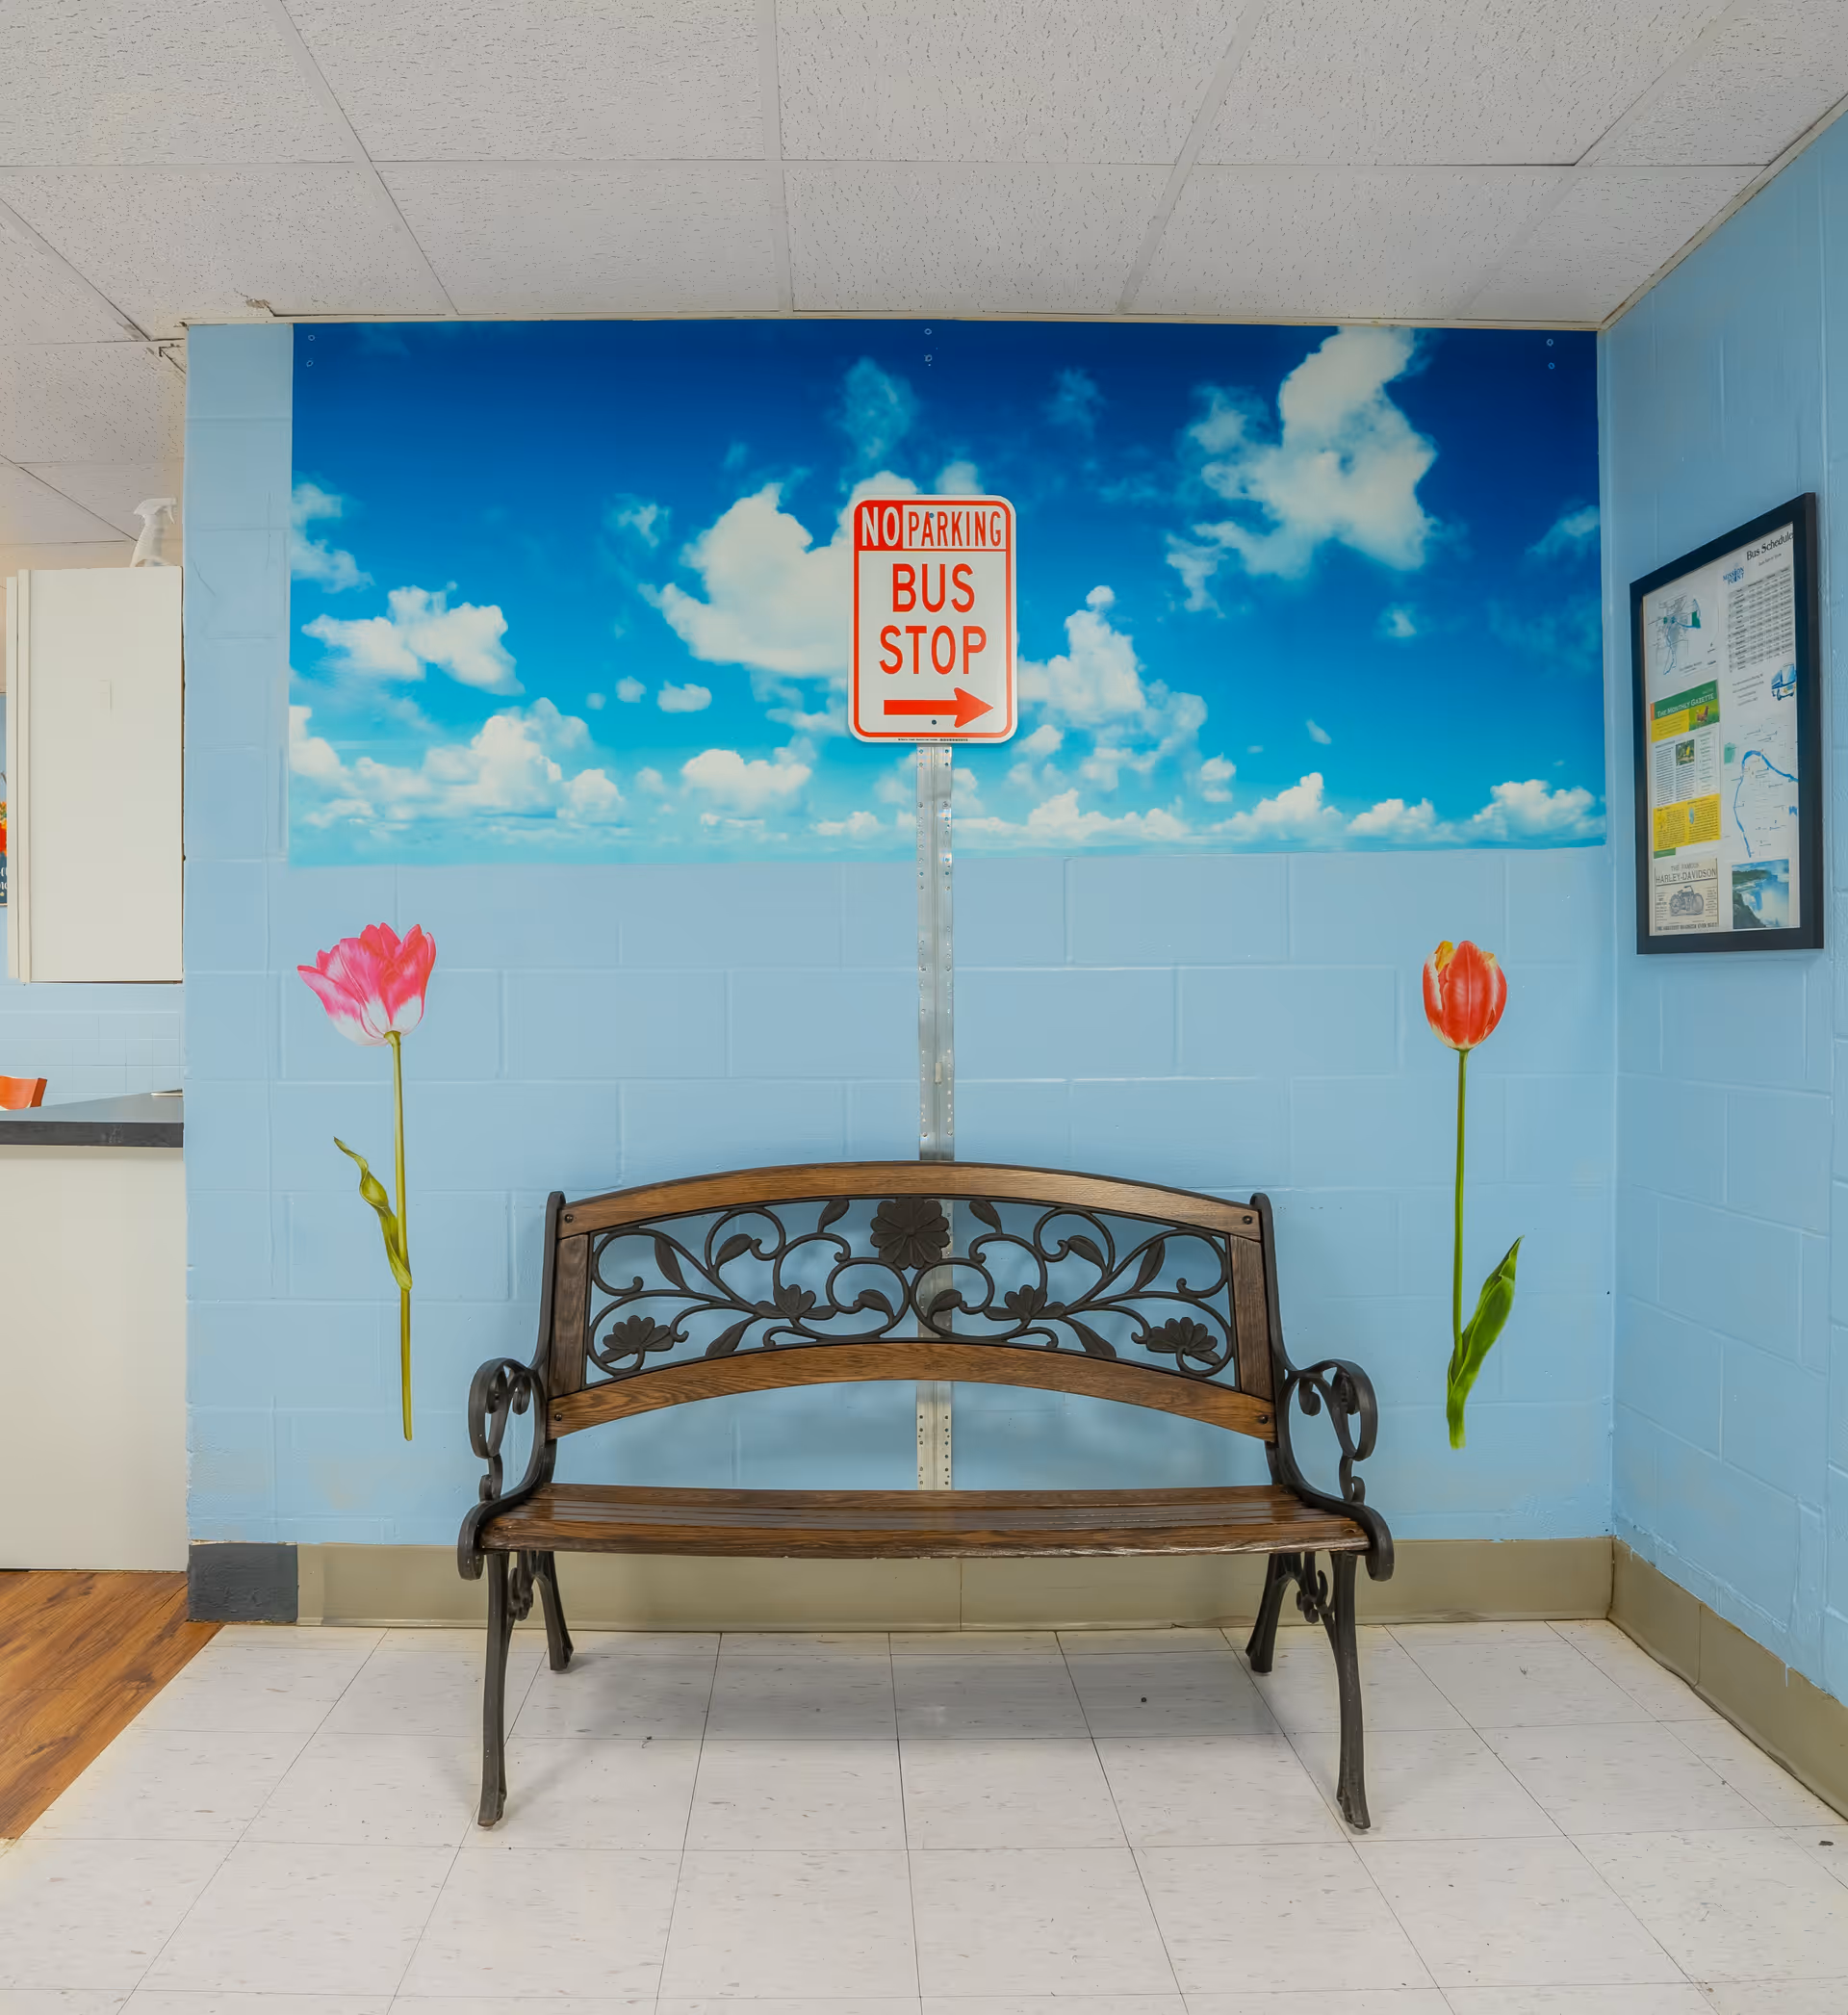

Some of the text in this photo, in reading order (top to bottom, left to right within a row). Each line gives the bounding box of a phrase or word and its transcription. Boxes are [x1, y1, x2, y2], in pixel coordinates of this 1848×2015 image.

[861, 506, 1002, 547] NO PARKING
[1746, 548, 1760, 561] Bus
[892, 563, 975, 613] BUS
[879, 625, 988, 675] STOP
[1690, 692, 1715, 707] GAZETTE
[1656, 867, 1717, 884] HARLEY-DAVIDSON
